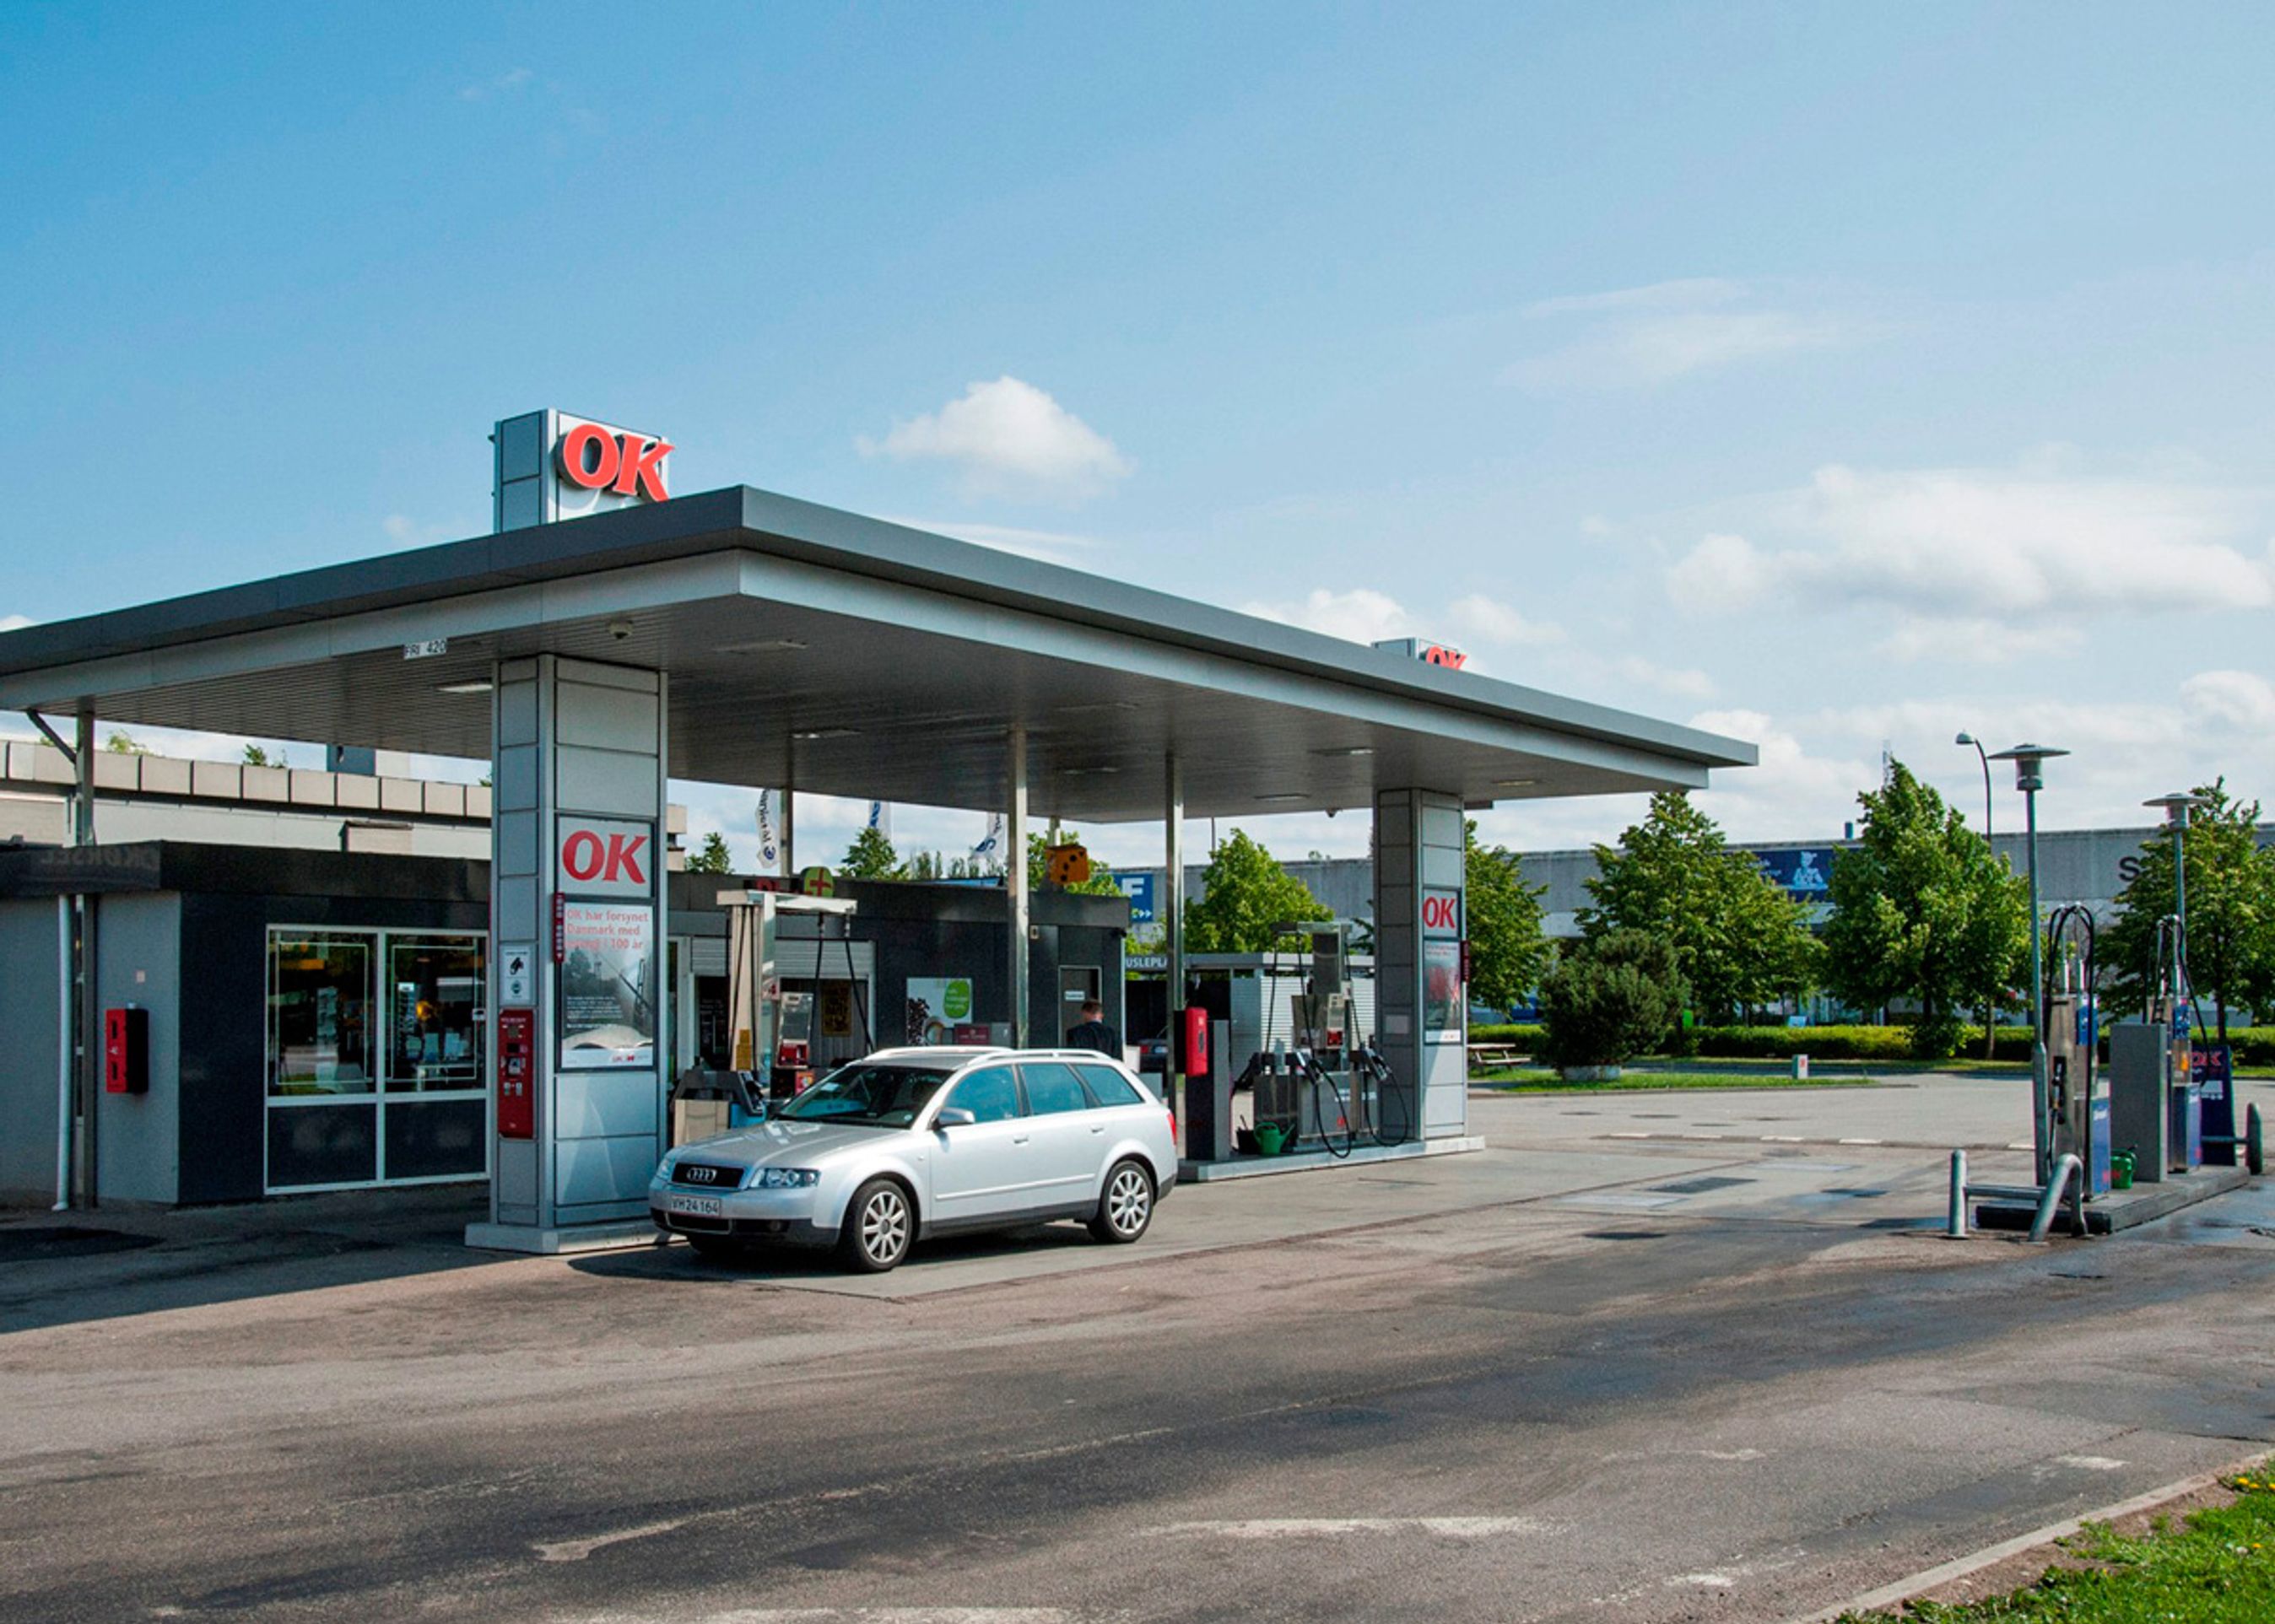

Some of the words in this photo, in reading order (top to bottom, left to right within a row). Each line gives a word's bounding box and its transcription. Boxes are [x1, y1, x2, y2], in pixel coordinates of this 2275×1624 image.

[563, 424, 675, 503] OK
[561, 829, 649, 884] OK
[586, 910, 603, 921] har
[607, 911, 649, 925] forsynet
[1423, 896, 1456, 929] OK
[618, 925, 640, 936] med
